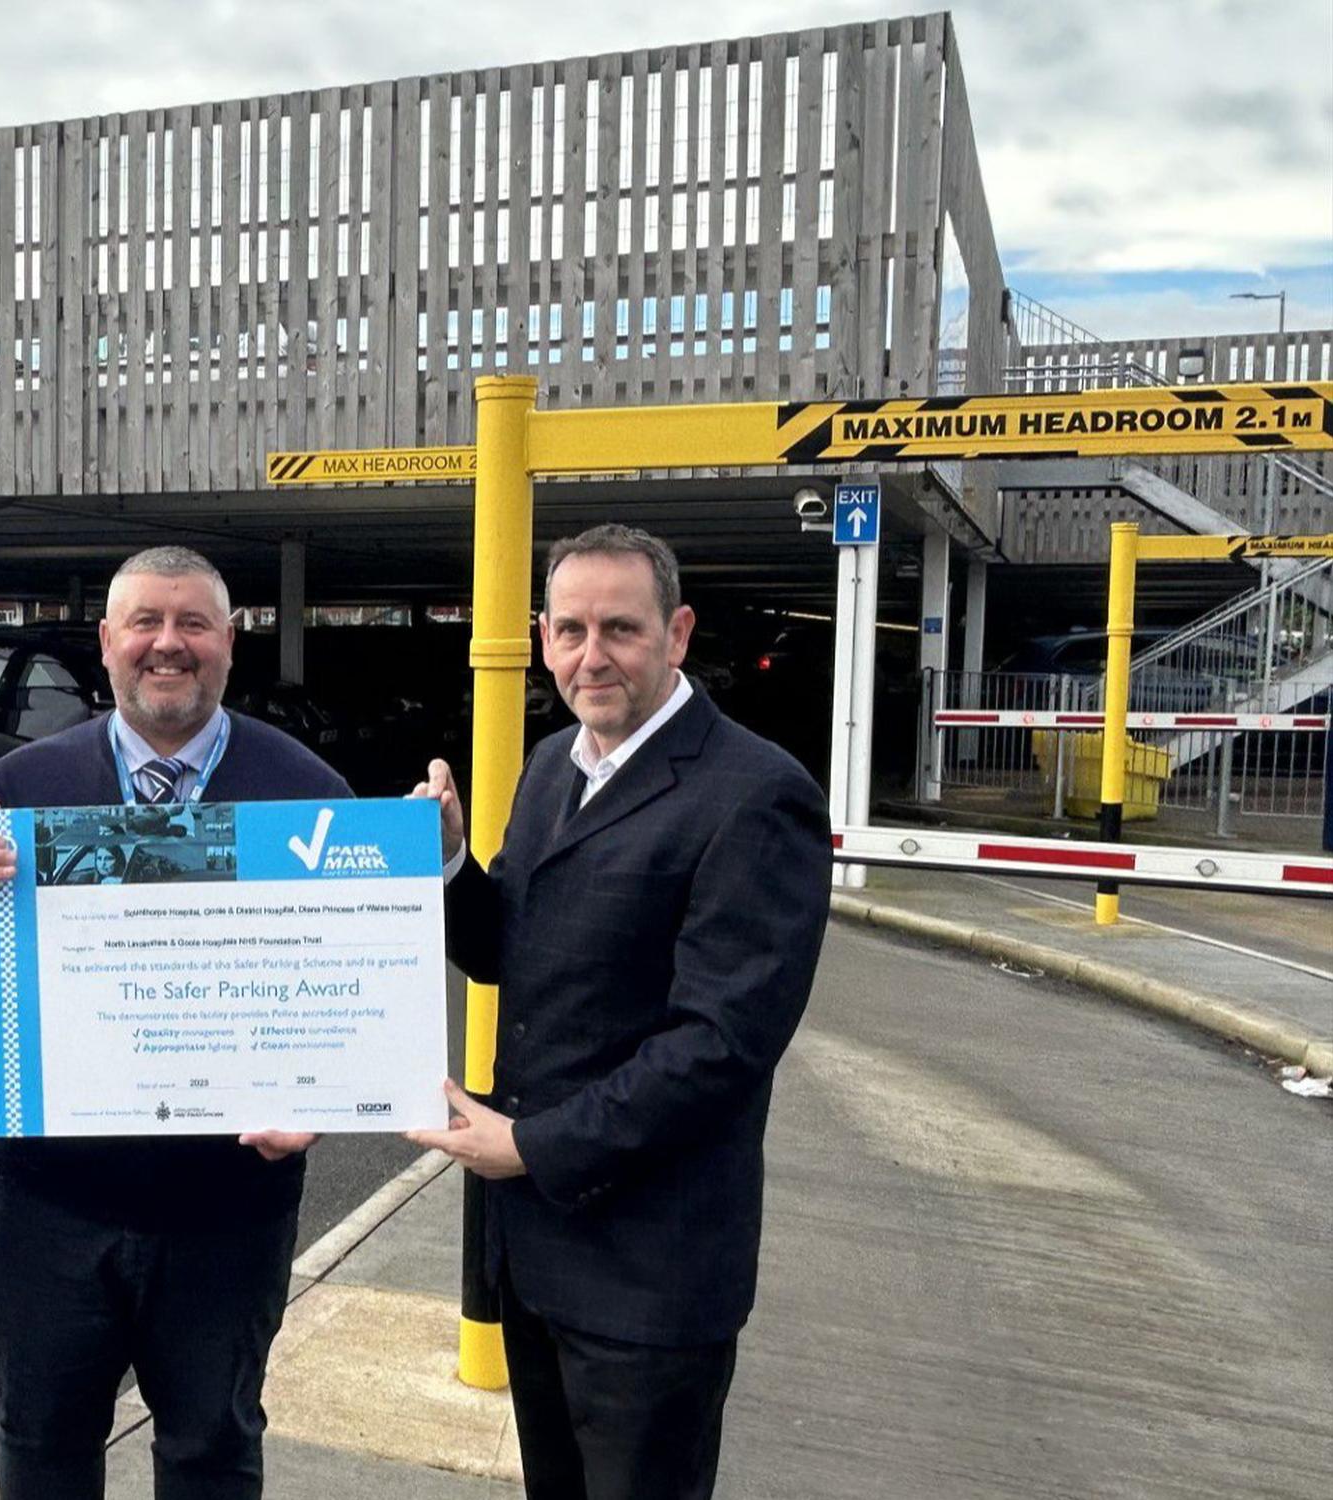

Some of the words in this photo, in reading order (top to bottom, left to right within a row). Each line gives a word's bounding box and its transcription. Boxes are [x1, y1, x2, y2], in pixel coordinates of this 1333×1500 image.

[842, 410, 1007, 441] MAXIMUM
[1018, 406, 1224, 437] HEADROOM
[323, 457, 359, 474] MAX
[363, 455, 462, 473] HEADROOM
[838, 489, 877, 505] EXIT
[1250, 541, 1305, 550] MAXIMUM
[326, 844, 382, 856] PARK
[323, 855, 389, 870] MARK
[228, 906, 234, 915] &
[236, 906, 262, 915] District
[299, 905, 321, 914] Diana
[322, 905, 355, 914] Princess
[357, 903, 365, 912] of
[366, 903, 389, 912] Wales
[391, 903, 422, 914] Hospital
[104, 939, 126, 949] North
[170, 938, 176, 947] &
[178, 938, 201, 947] Goole
[239, 937, 257, 946] NHS
[259, 937, 302, 946] Foundation
[303, 935, 322, 944] Trust
[130, 961, 147, 972] the
[150, 960, 199, 972] standards
[201, 960, 212, 970] of
[214, 959, 231, 970] the
[234, 958, 259, 969] Safer
[262, 958, 300, 970] Parking
[303, 957, 343, 968] Scheme
[346, 957, 365, 968] and
[367, 957, 375, 967] is
[378, 955, 418, 968] granted
[119, 981, 157, 1000] The
[163, 981, 211, 999] Safer
[219, 980, 289, 1002] Parking
[296, 978, 360, 997] Award
[97, 1011, 116, 1020] This
[118, 1011, 180, 1020] demonstrates
[182, 1011, 197, 1019] the
[272, 1008, 298, 1018] Police
[302, 1008, 348, 1018] accredited
[351, 1007, 386, 1018] parking
[142, 1029, 180, 1039] Quality
[260, 1026, 306, 1036] Effective
[143, 1043, 206, 1053] Appropriate
[260, 1041, 291, 1050] Clean
